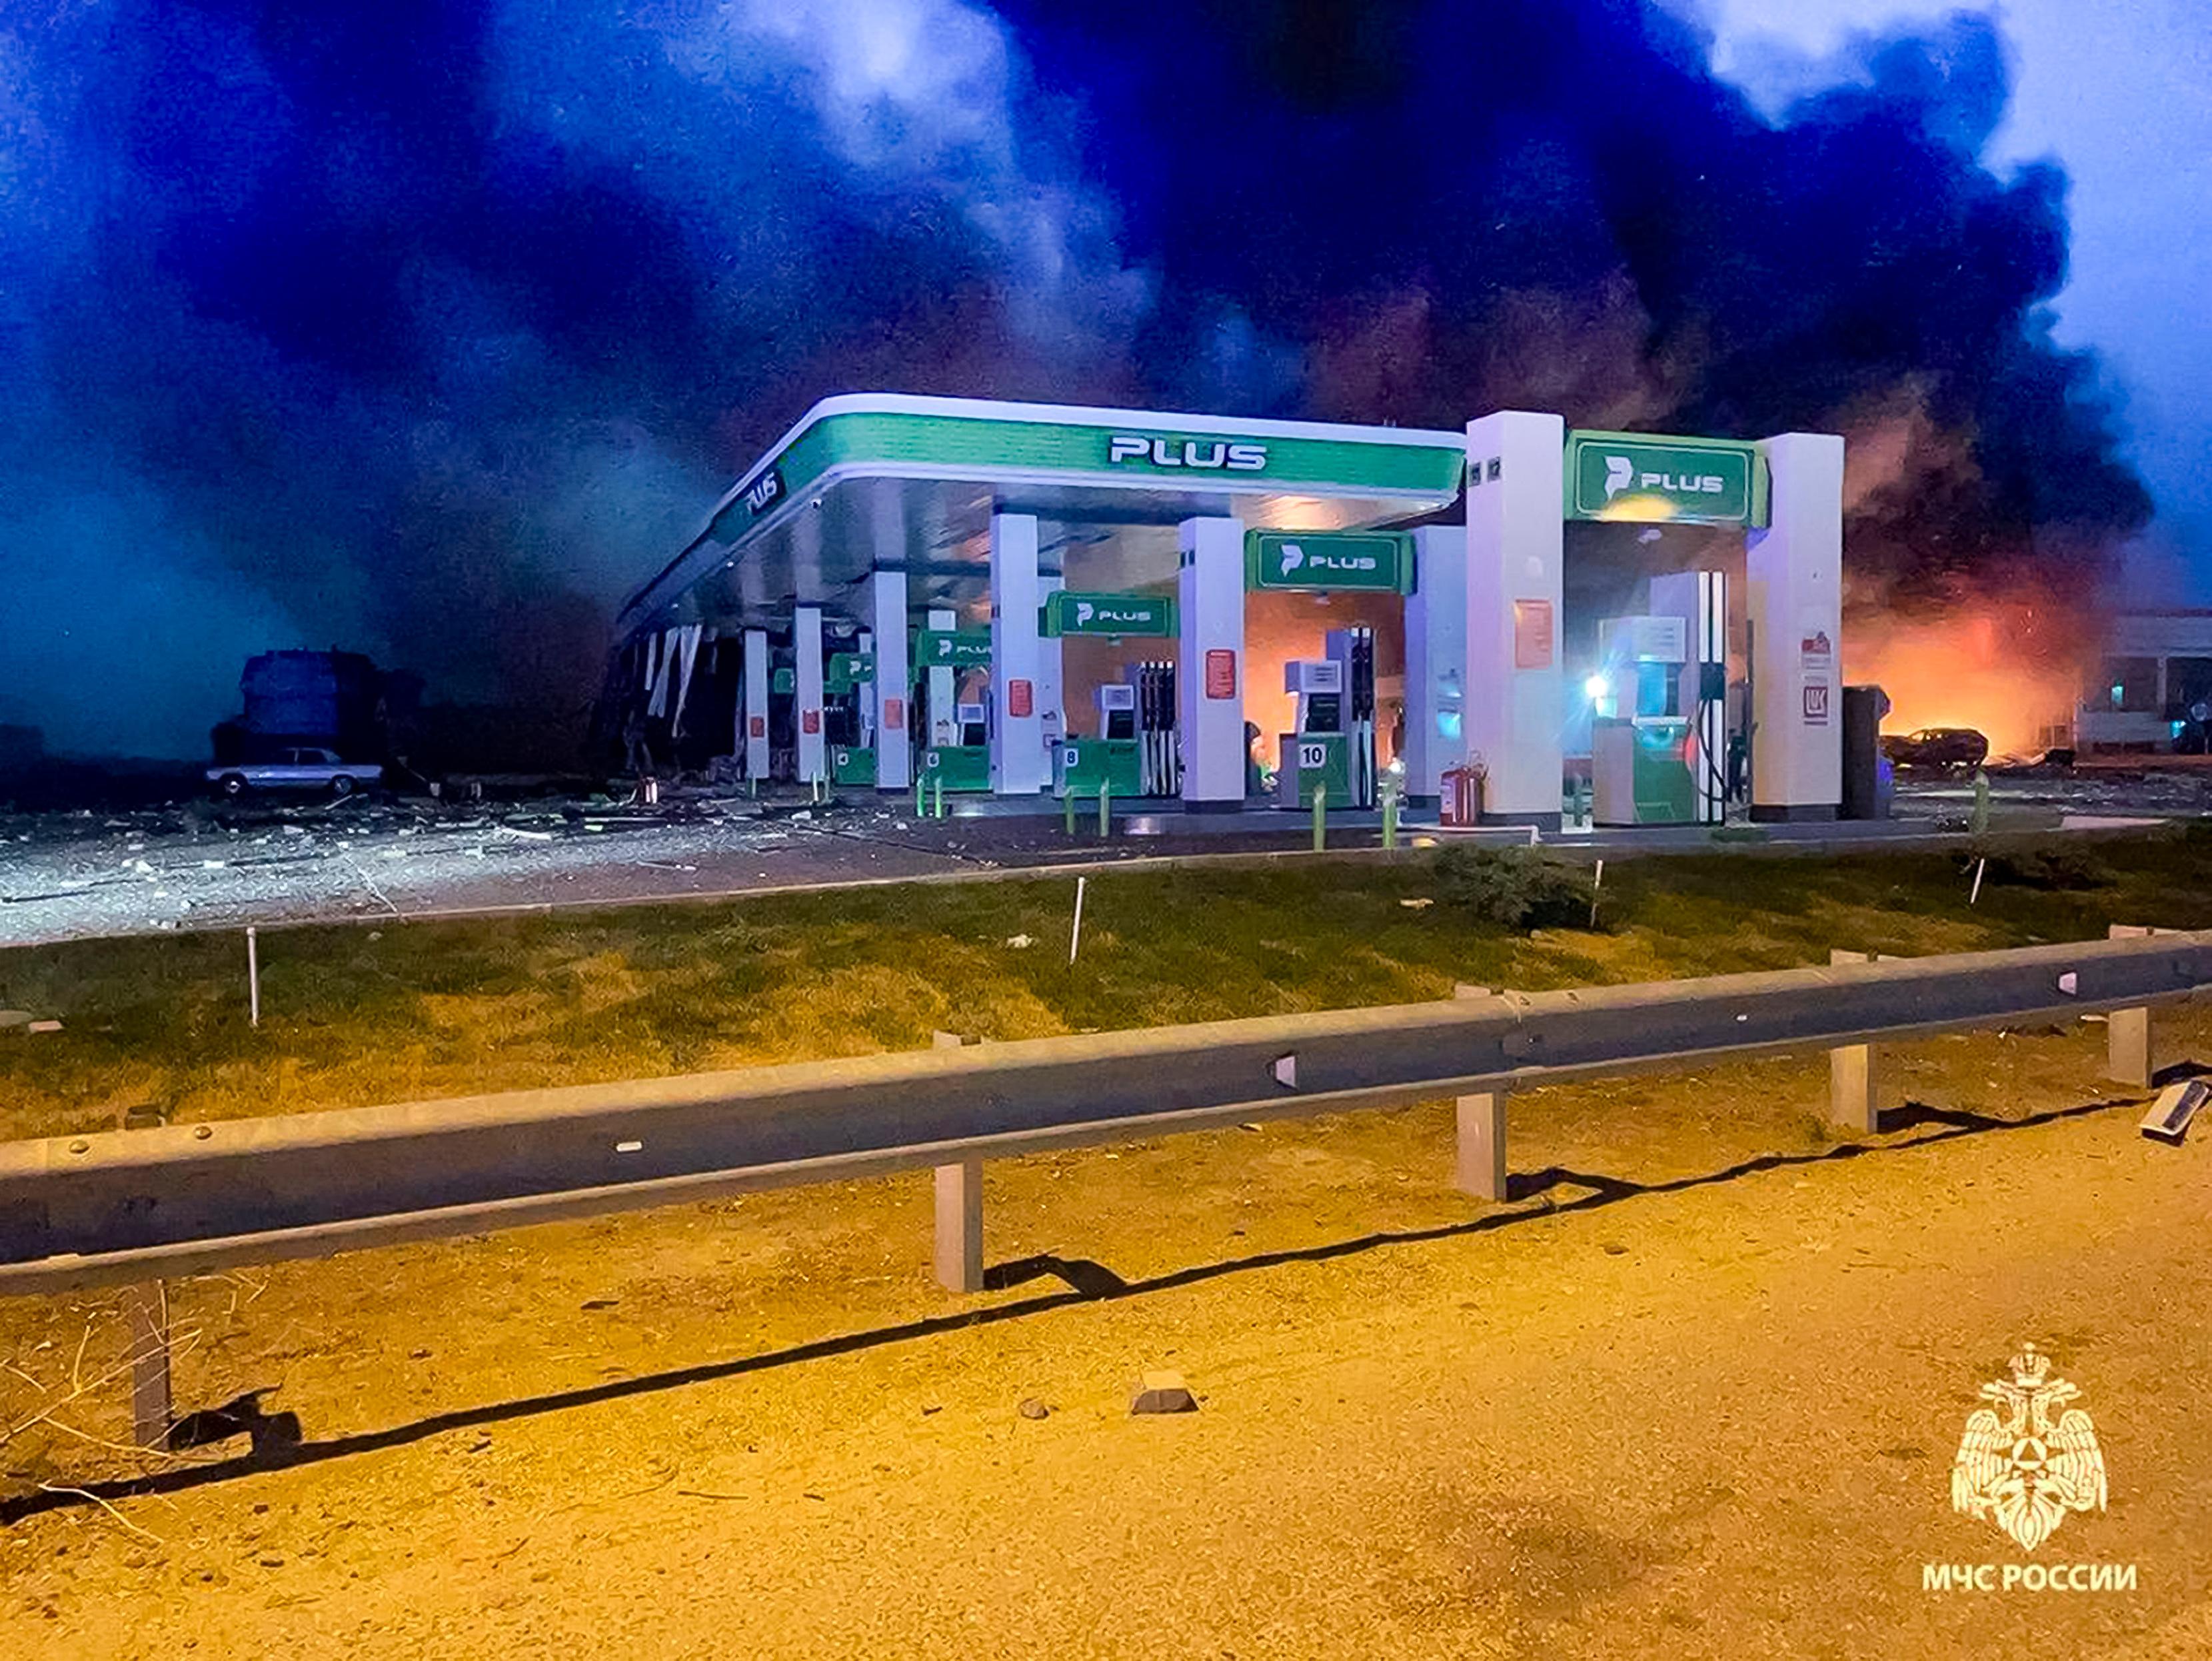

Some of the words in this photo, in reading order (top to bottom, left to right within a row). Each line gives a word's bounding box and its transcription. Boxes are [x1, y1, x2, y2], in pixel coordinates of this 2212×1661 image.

[1111, 437, 1266, 470] PLUS
[1641, 472, 1724, 493] PLUS
[1309, 555, 1376, 571] PLUS
[1098, 610, 1152, 621] PLUS
[1067, 751, 1076, 764] 8
[1302, 747, 1322, 764] 10
